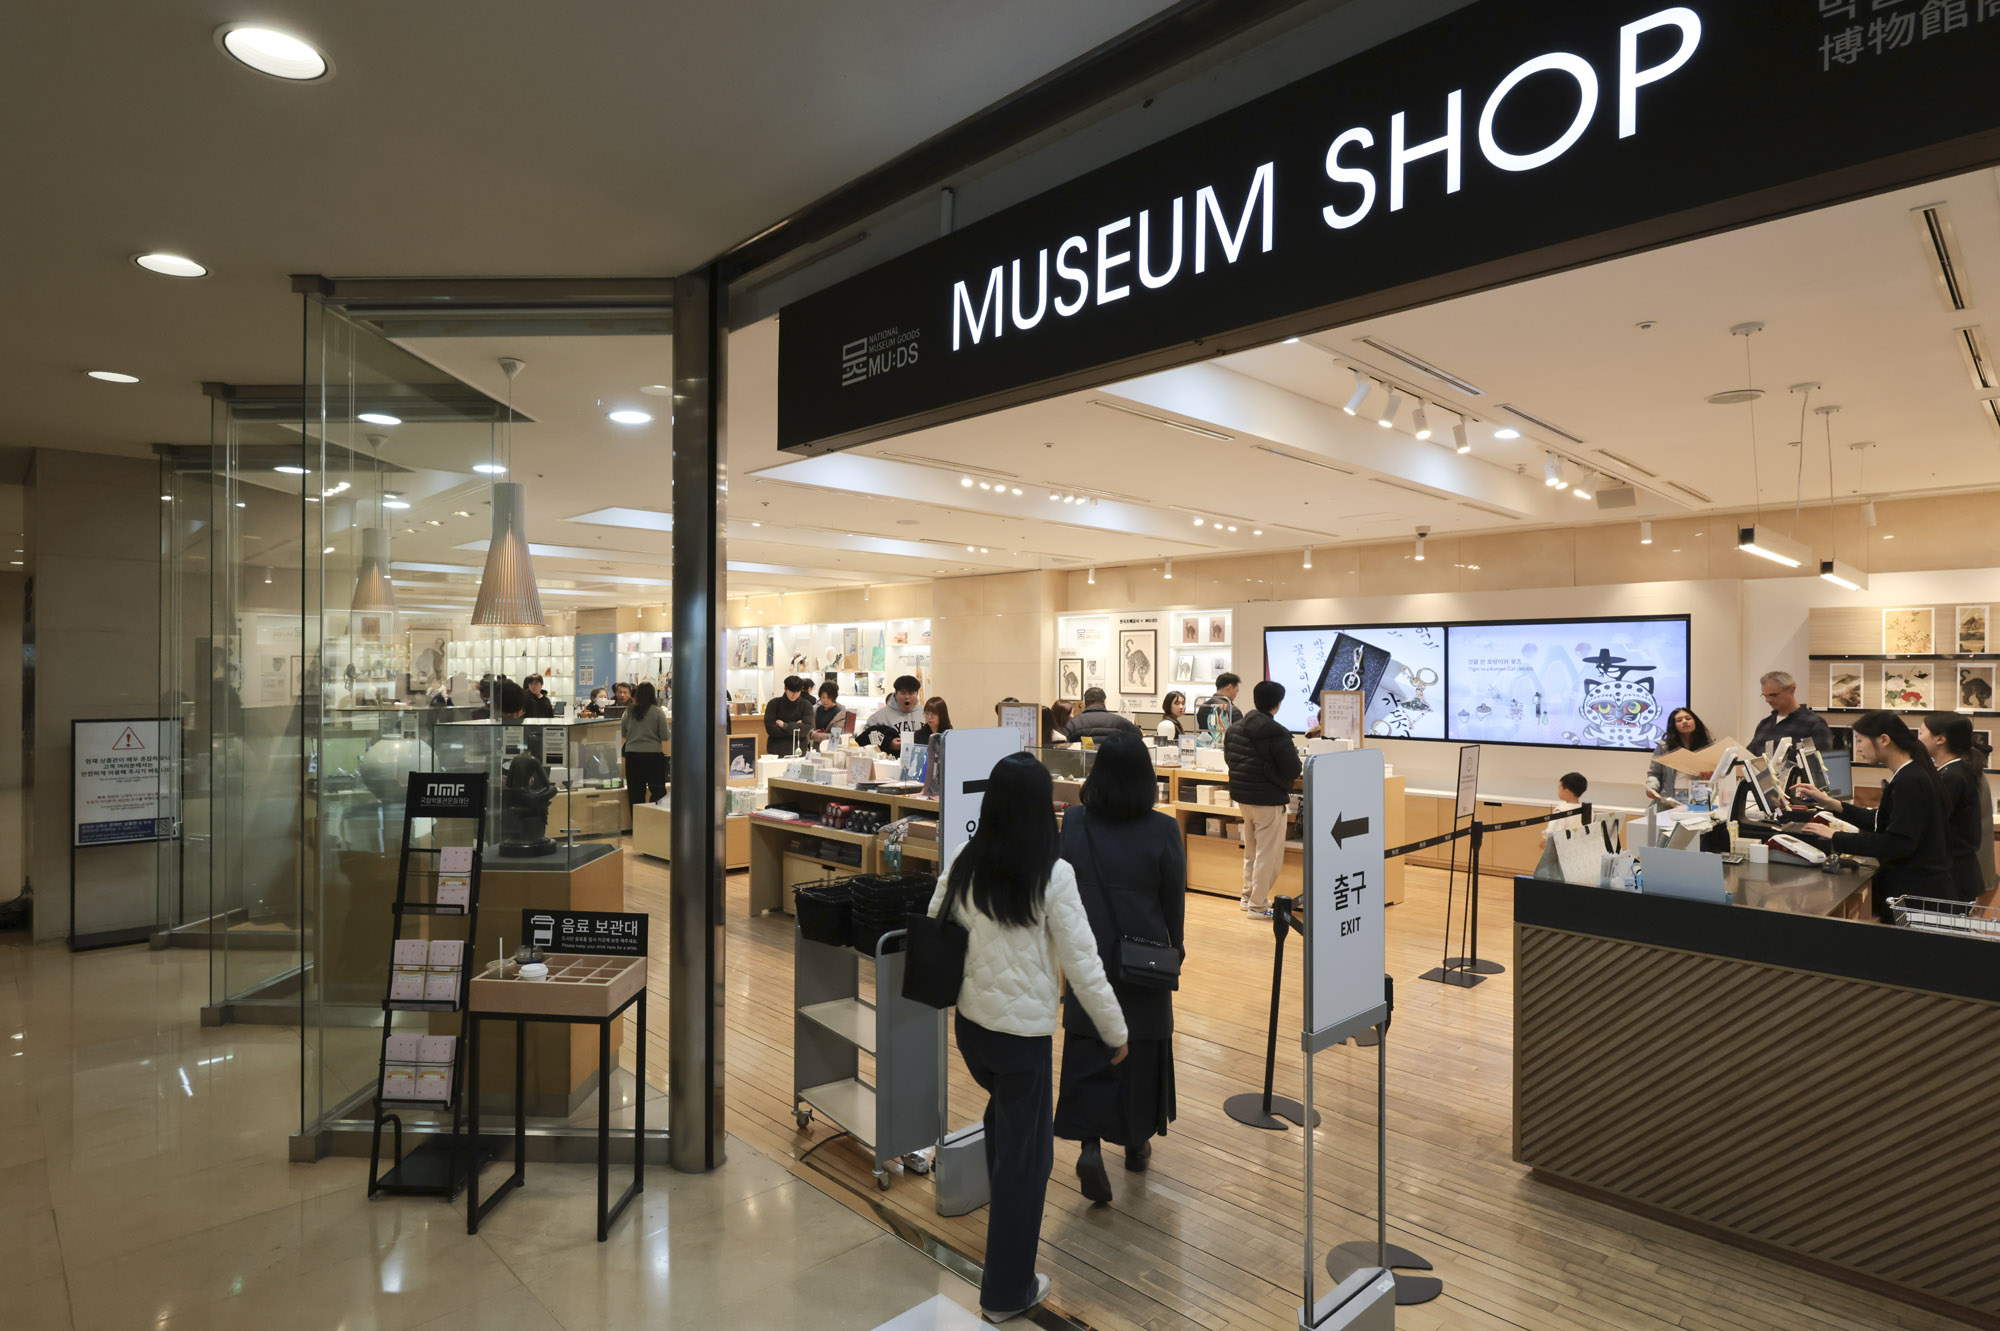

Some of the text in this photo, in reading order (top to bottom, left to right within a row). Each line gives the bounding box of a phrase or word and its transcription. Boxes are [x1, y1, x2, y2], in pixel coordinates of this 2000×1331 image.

[952, 6, 1702, 352] MUSEUM SHOP
[868, 328, 921, 354] MUSEUM GOODS
[869, 326, 899, 344] NATIONAL
[868, 342, 919, 377] MU:DS
[1333, 870, 1367, 911] 출구
[561, 918, 638, 937] 음료 보관대
[1340, 916, 1362, 937] EXIT
